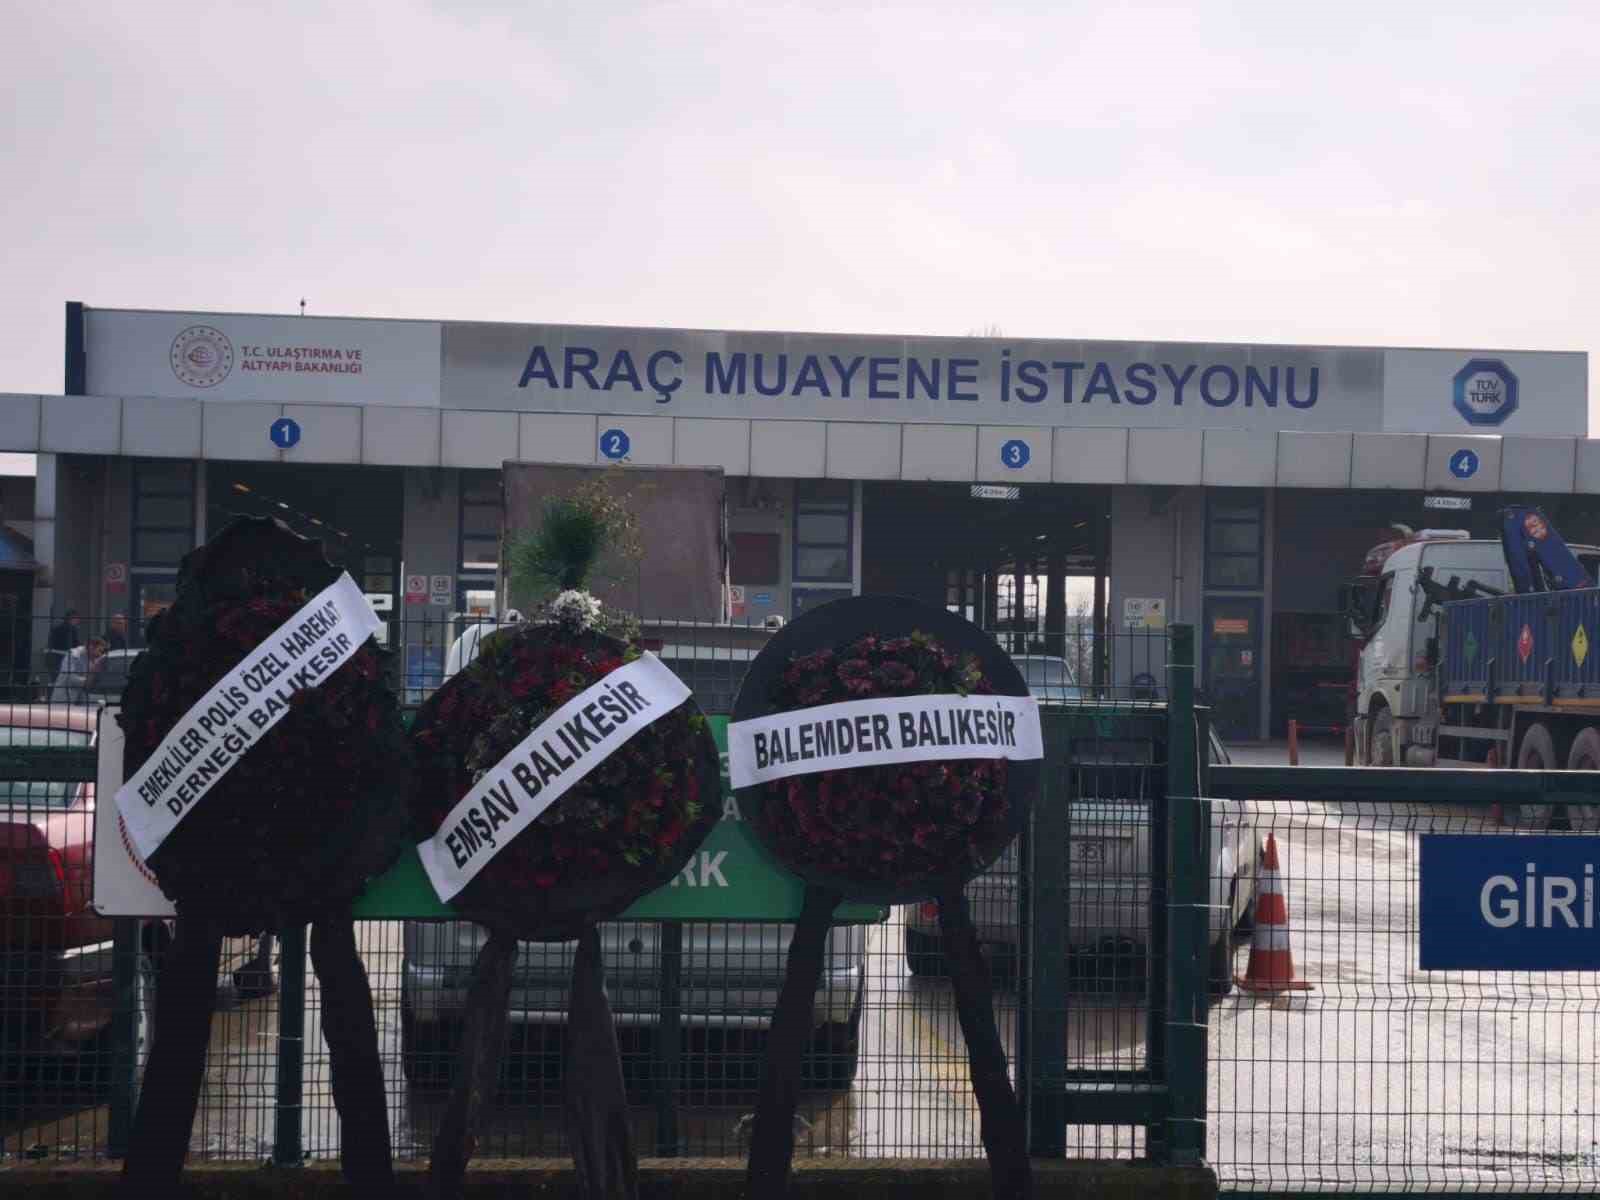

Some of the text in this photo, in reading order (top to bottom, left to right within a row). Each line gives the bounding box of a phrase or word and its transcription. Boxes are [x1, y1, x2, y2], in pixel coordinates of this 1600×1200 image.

[241, 346, 363, 360] T.C. ULAŞTIRMA VE
[241, 360, 362, 374] ALTYAPI BAKANLIĞI
[518, 346, 1319, 409] ARAÇ MUAYENE İSTASYONU
[281, 425, 289, 442] 1
[610, 435, 621, 453] 2
[1010, 446, 1021, 464] 3
[1458, 456, 1469, 473] 4
[138, 600, 342, 807] EMEKLİLER POLİS ÖZEL HAREKAT
[167, 632, 353, 817] DERNEĞİ BALIKESİR
[753, 723, 893, 769] BALEMDER
[899, 702, 1017, 748] BALIKESİR
[444, 681, 650, 869] EMŞAV BALIKESİR
[671, 850, 729, 887] RK
[1480, 863, 1599, 928] GİRİ
